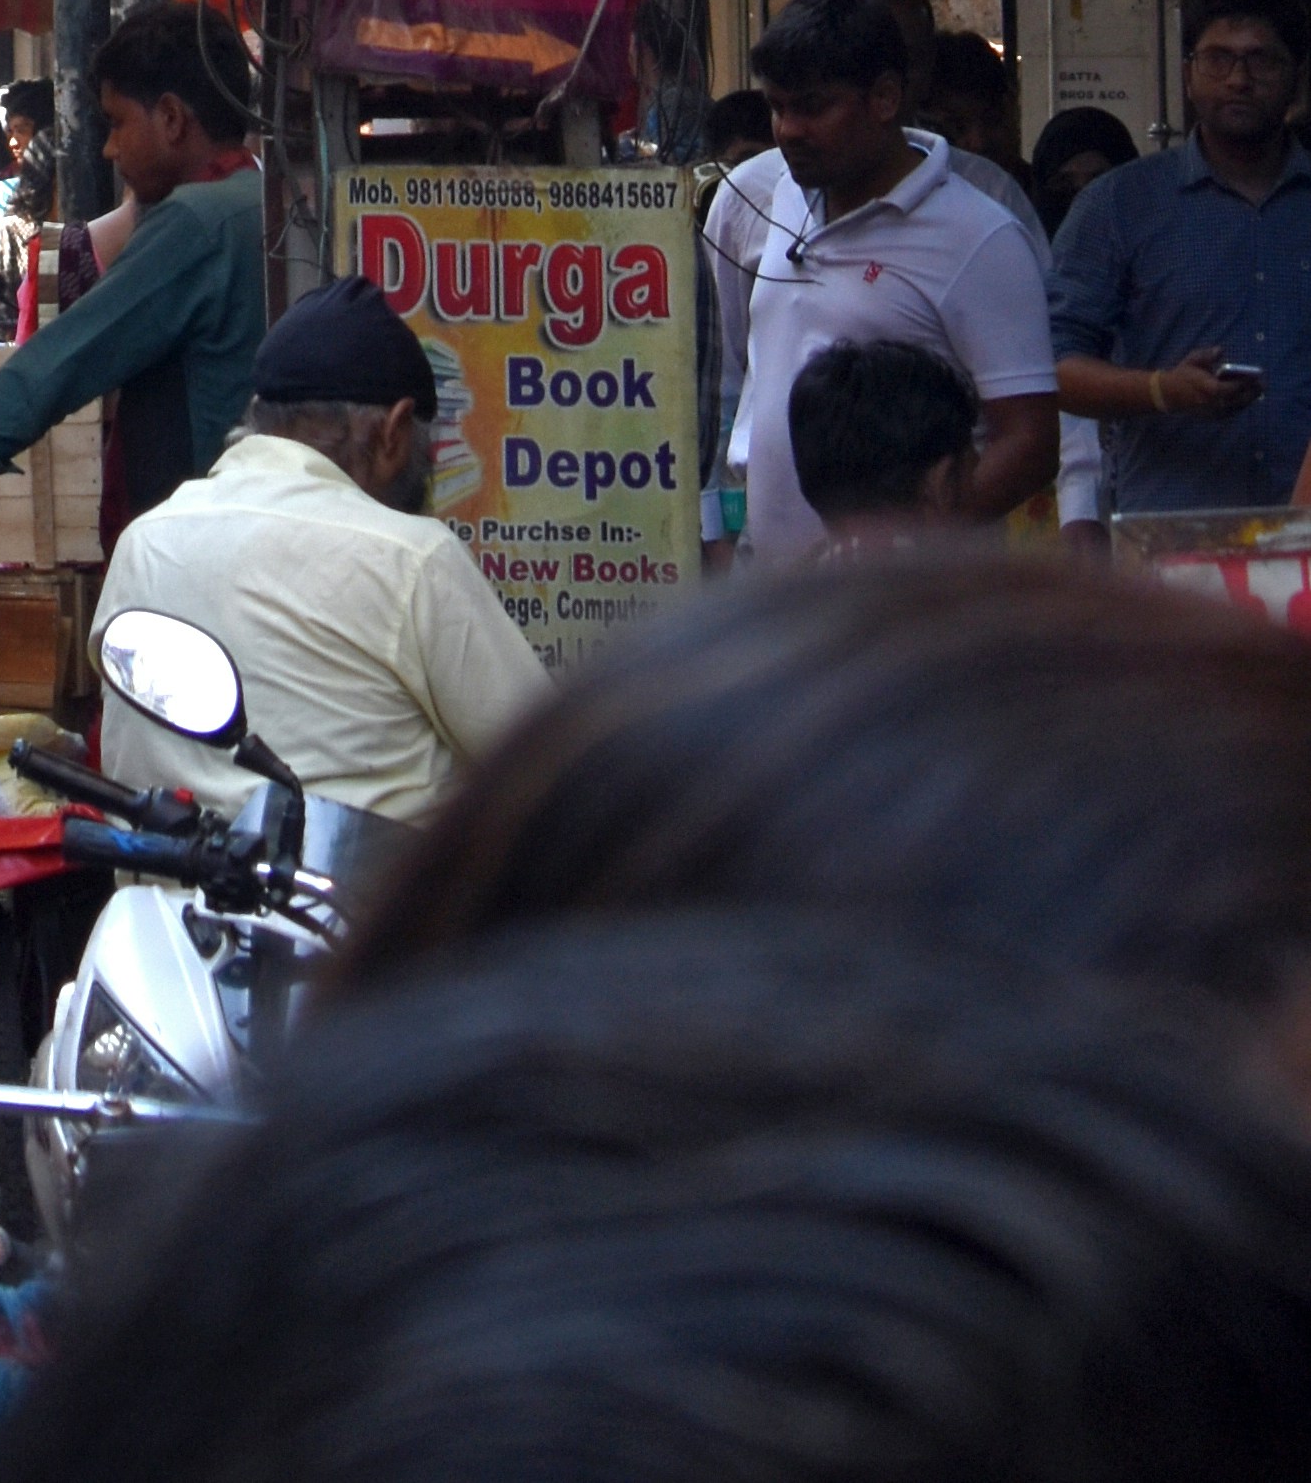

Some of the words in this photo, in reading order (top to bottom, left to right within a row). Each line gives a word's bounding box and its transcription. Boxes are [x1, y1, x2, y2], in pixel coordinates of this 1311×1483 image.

[348, 176, 400, 206] Mob.
[548, 180, 678, 209] 9868415687
[357, 212, 671, 347] Durga
[506, 356, 657, 410] Book
[504, 436, 677, 502] Depot
[481, 520, 591, 543] Purchse
[481, 552, 560, 583] New
[572, 553, 679, 585] Books
